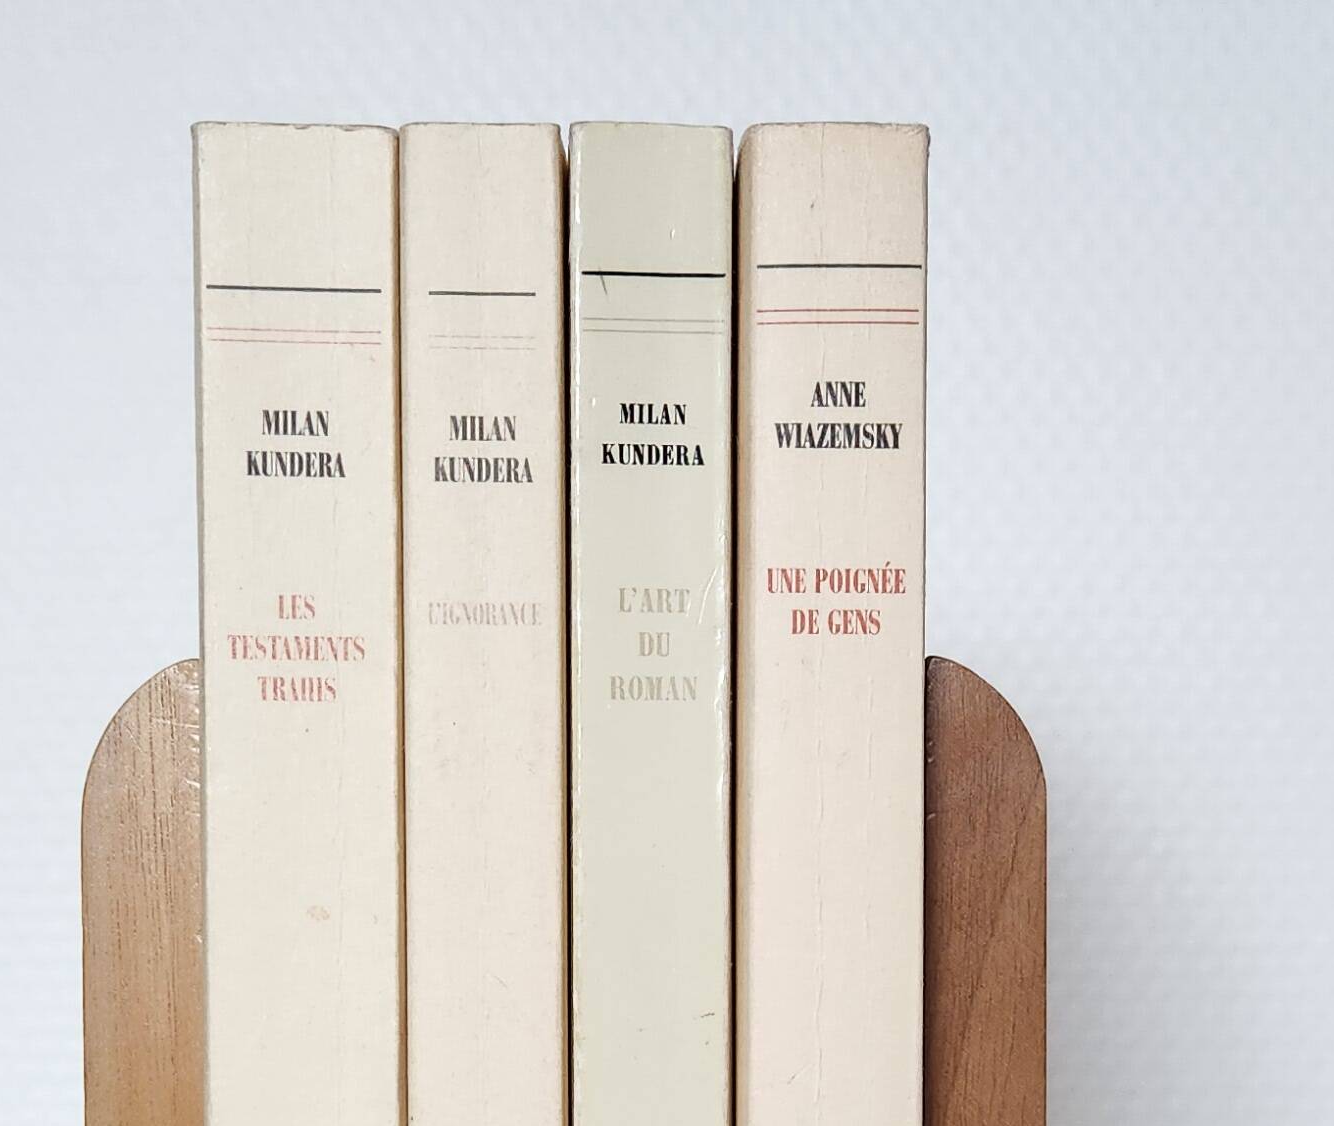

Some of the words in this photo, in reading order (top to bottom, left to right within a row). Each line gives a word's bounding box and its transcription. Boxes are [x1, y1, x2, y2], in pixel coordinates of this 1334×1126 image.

[810, 381, 866, 409] ANNE
[260, 409, 329, 437] MILAN
[619, 403, 687, 426] MILAN
[449, 415, 517, 443] MILAN
[774, 422, 904, 450] WIAZEMSKY
[246, 449, 346, 479] KUNDERA
[601, 441, 706, 467] KUNDERA
[433, 456, 533, 484] KUNDERA
[767, 567, 809, 595] UNE
[815, 560, 907, 595] POIGNÉE
[277, 594, 317, 621] LES
[618, 587, 690, 615] L'ART
[791, 608, 822, 635] DE
[827, 608, 882, 635] GENS
[227, 634, 366, 662] TESTAMENTS
[638, 631, 670, 657] DU
[609, 675, 697, 701] ROMAN
